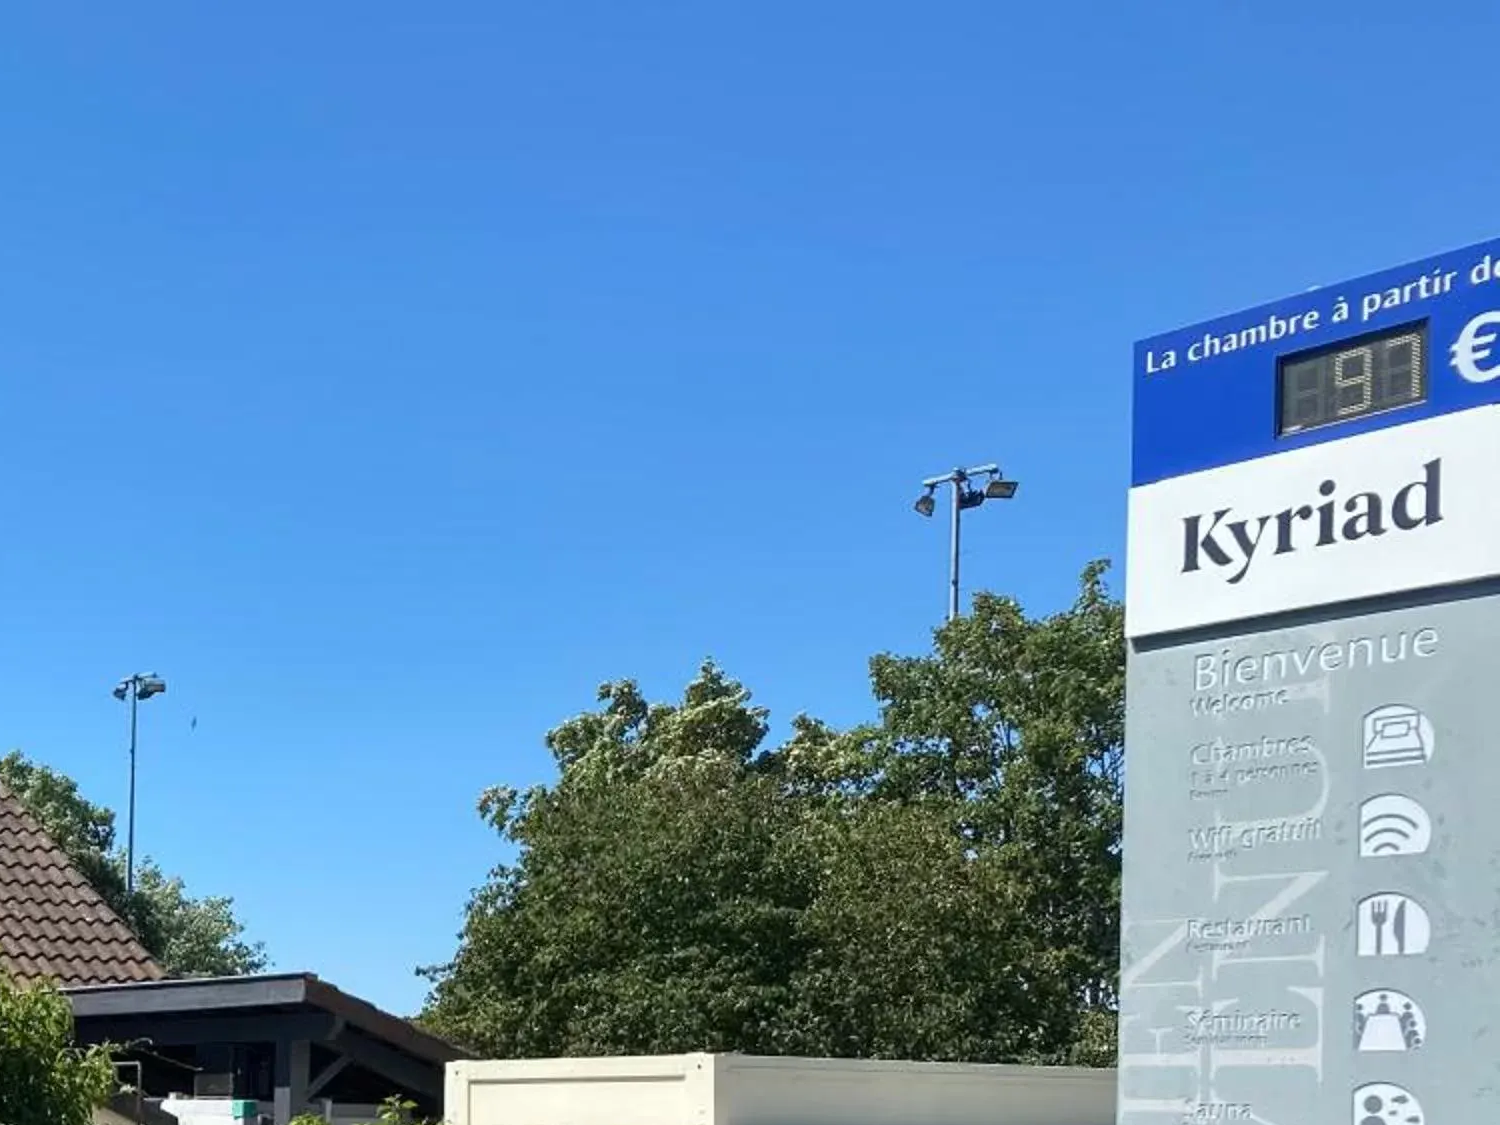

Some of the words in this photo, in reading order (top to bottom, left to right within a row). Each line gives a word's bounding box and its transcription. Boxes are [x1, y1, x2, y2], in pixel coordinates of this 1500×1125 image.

[1146, 350, 1177, 374] La
[1188, 307, 1321, 361] chambre
[1331, 295, 1349, 323] à
[1362, 267, 1458, 321] partir
[1334, 332, 1422, 417] 97
[1180, 457, 1445, 585] Kyriad
[1193, 626, 1440, 692] Bienvenue
[1189, 688, 1290, 717] Welcome
[1189, 734, 1313, 766] Chambres
[1188, 824, 1233, 851] Wifi
[1241, 816, 1323, 850] gratuit
[1187, 913, 1311, 940] Restaurant
[1185, 1008, 1301, 1037] Séminaire
[1183, 1097, 1253, 1121] Sauna
